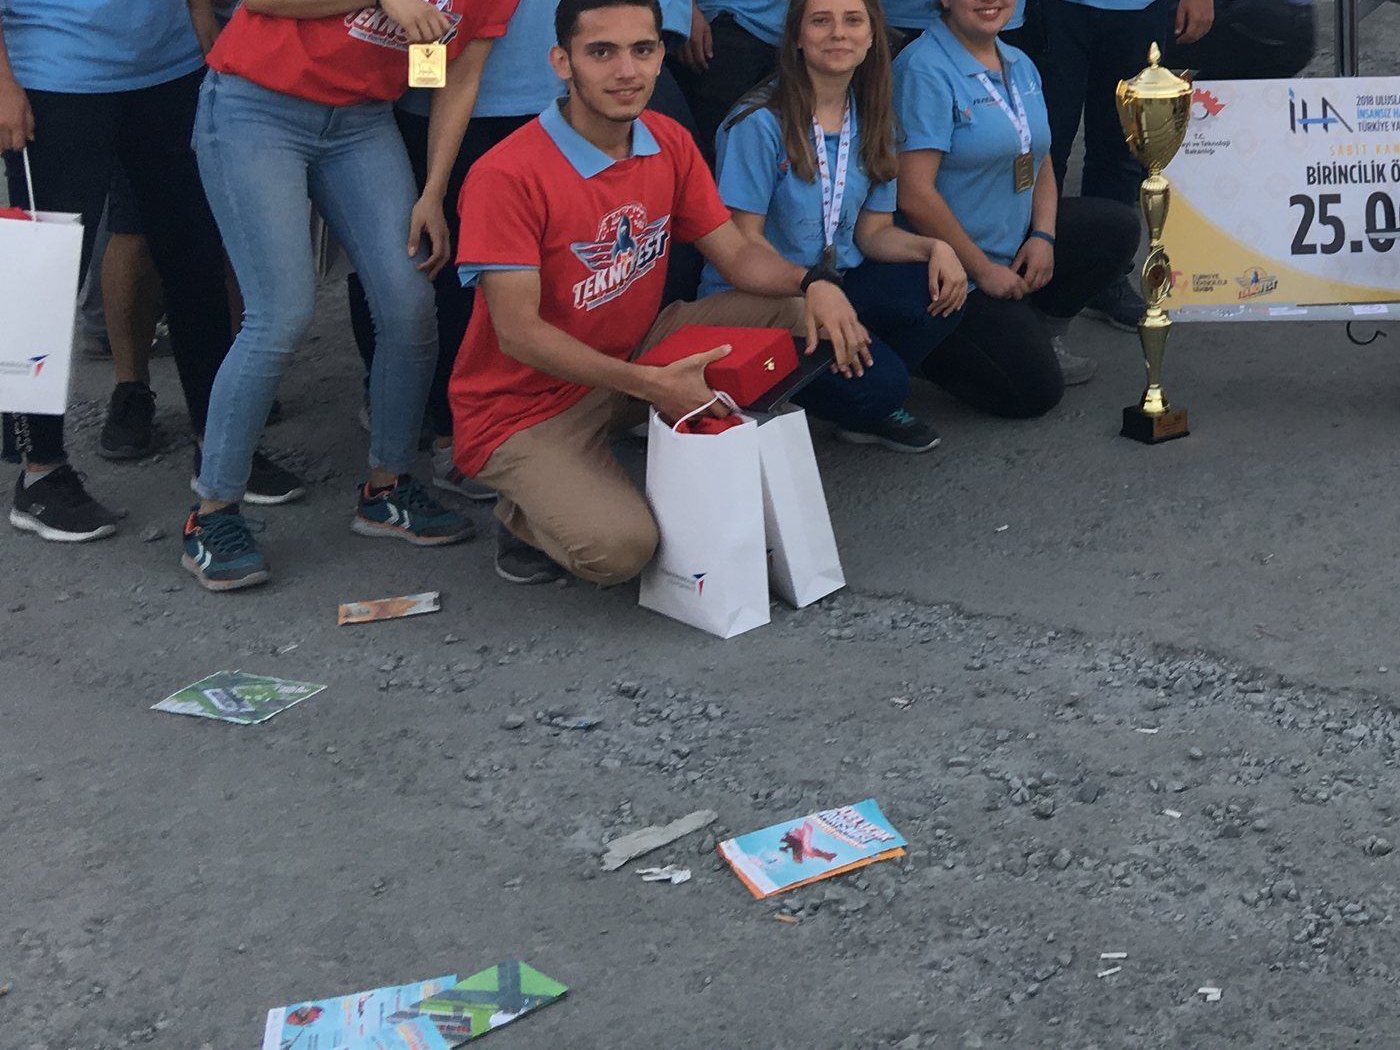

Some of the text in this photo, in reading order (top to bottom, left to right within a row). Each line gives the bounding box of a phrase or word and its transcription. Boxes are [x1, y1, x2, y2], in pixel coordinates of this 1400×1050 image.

[1356, 95, 1374, 106] 2018
[1358, 119, 1389, 132] TÜRKİYE
[1306, 159, 1387, 186] BİRİNCİLİK
